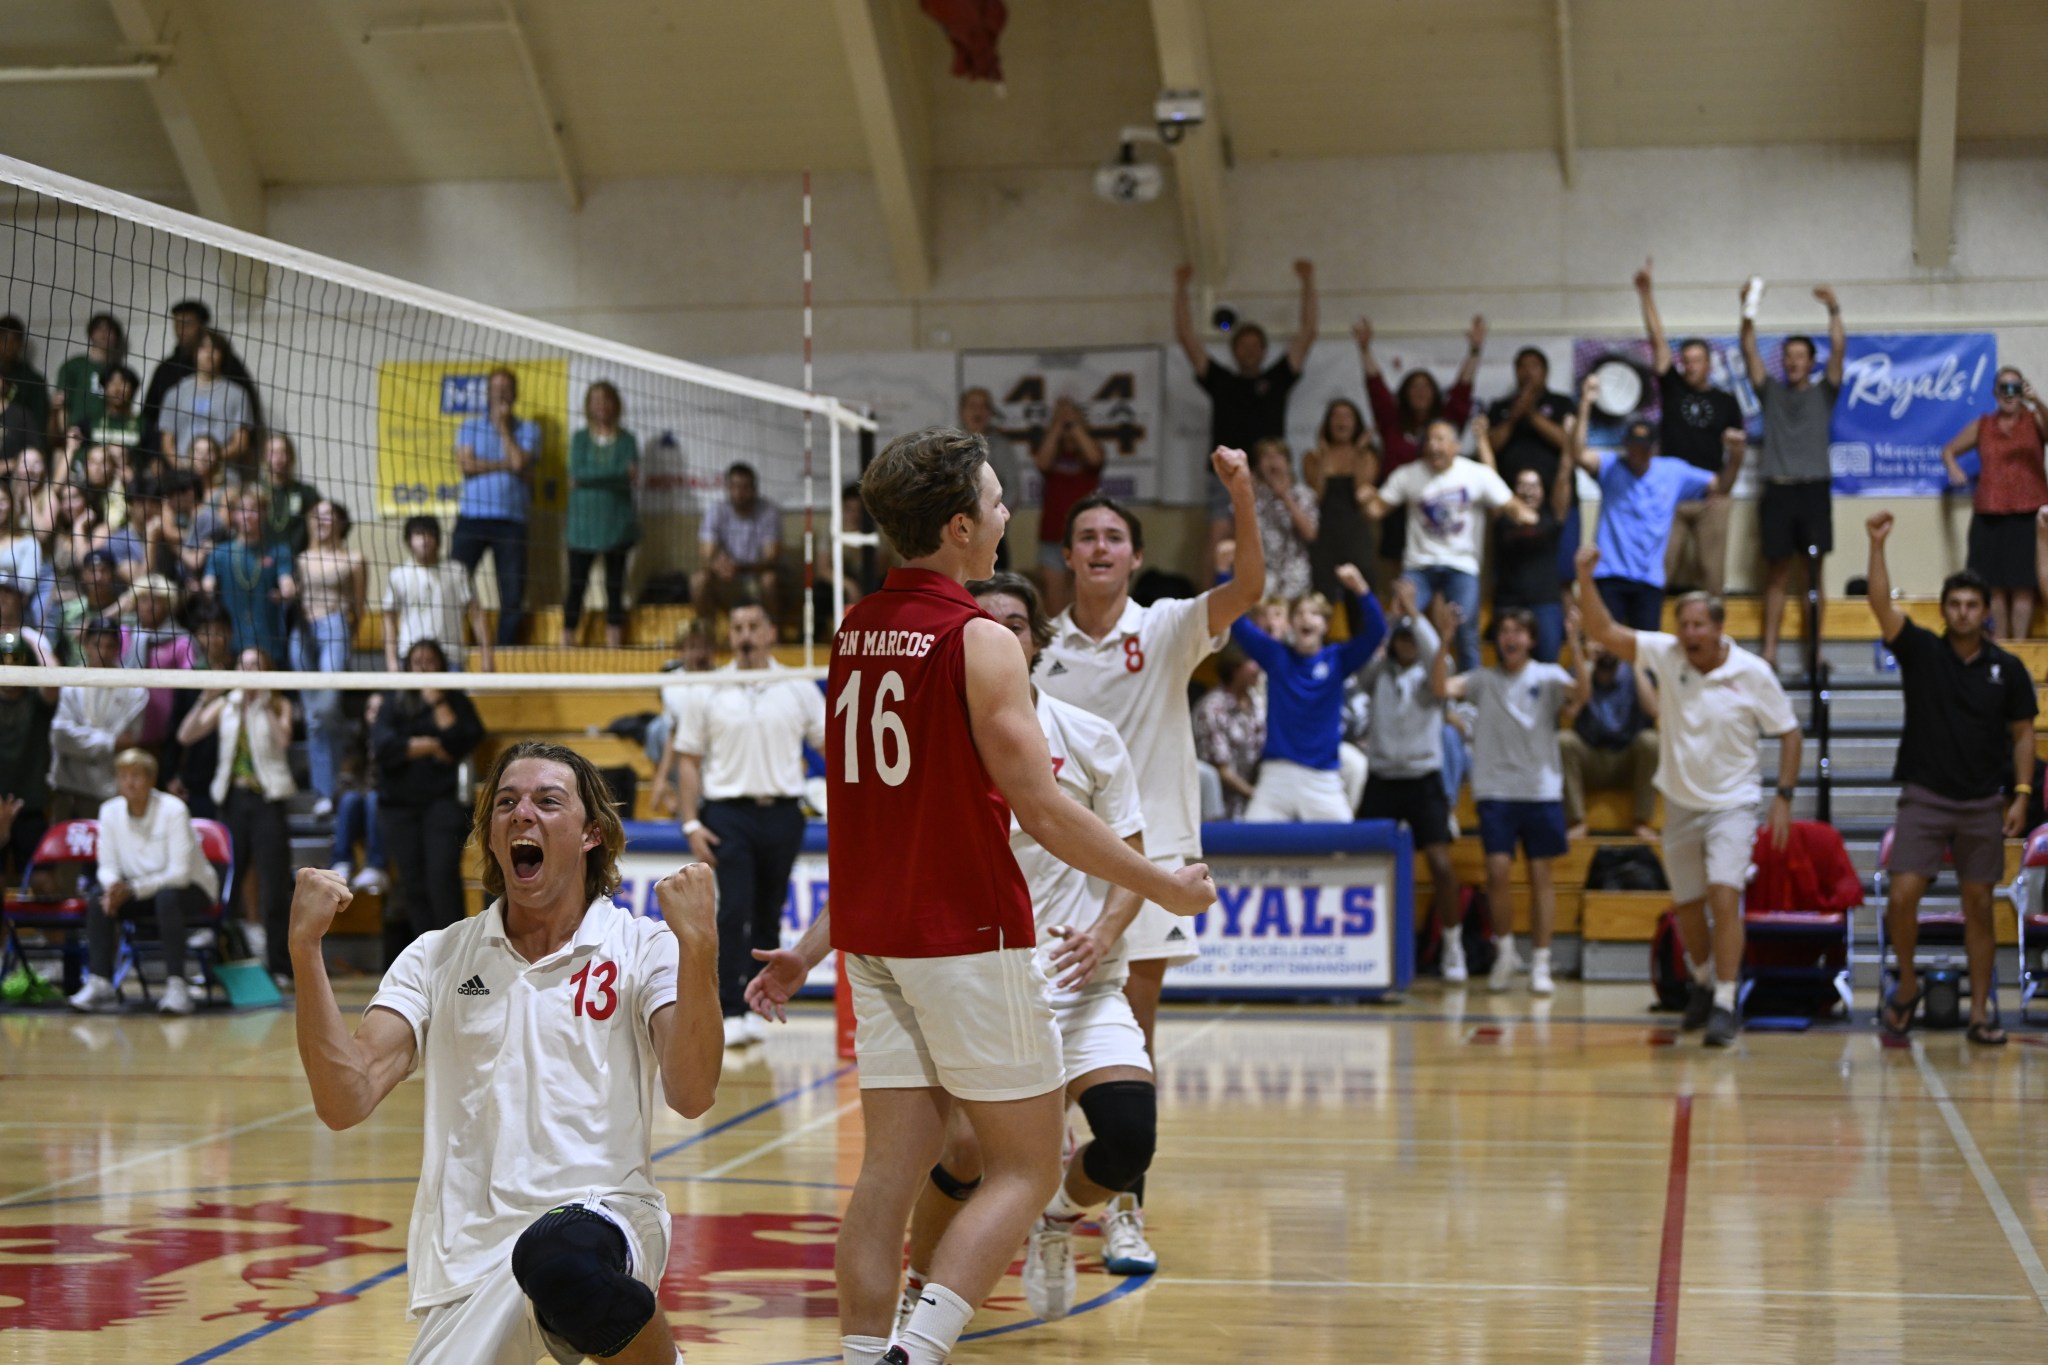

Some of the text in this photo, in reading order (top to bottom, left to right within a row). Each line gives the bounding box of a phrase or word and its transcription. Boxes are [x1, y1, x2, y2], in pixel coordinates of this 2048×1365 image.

[1842, 352, 1987, 420] Royals!
[862, 630, 935, 657] MARCOS
[1123, 636, 1145, 674] 8
[834, 670, 911, 787] 16
[1195, 885, 1377, 938] YALS
[457, 987, 490, 996] adidas
[570, 960, 617, 1021] 13
